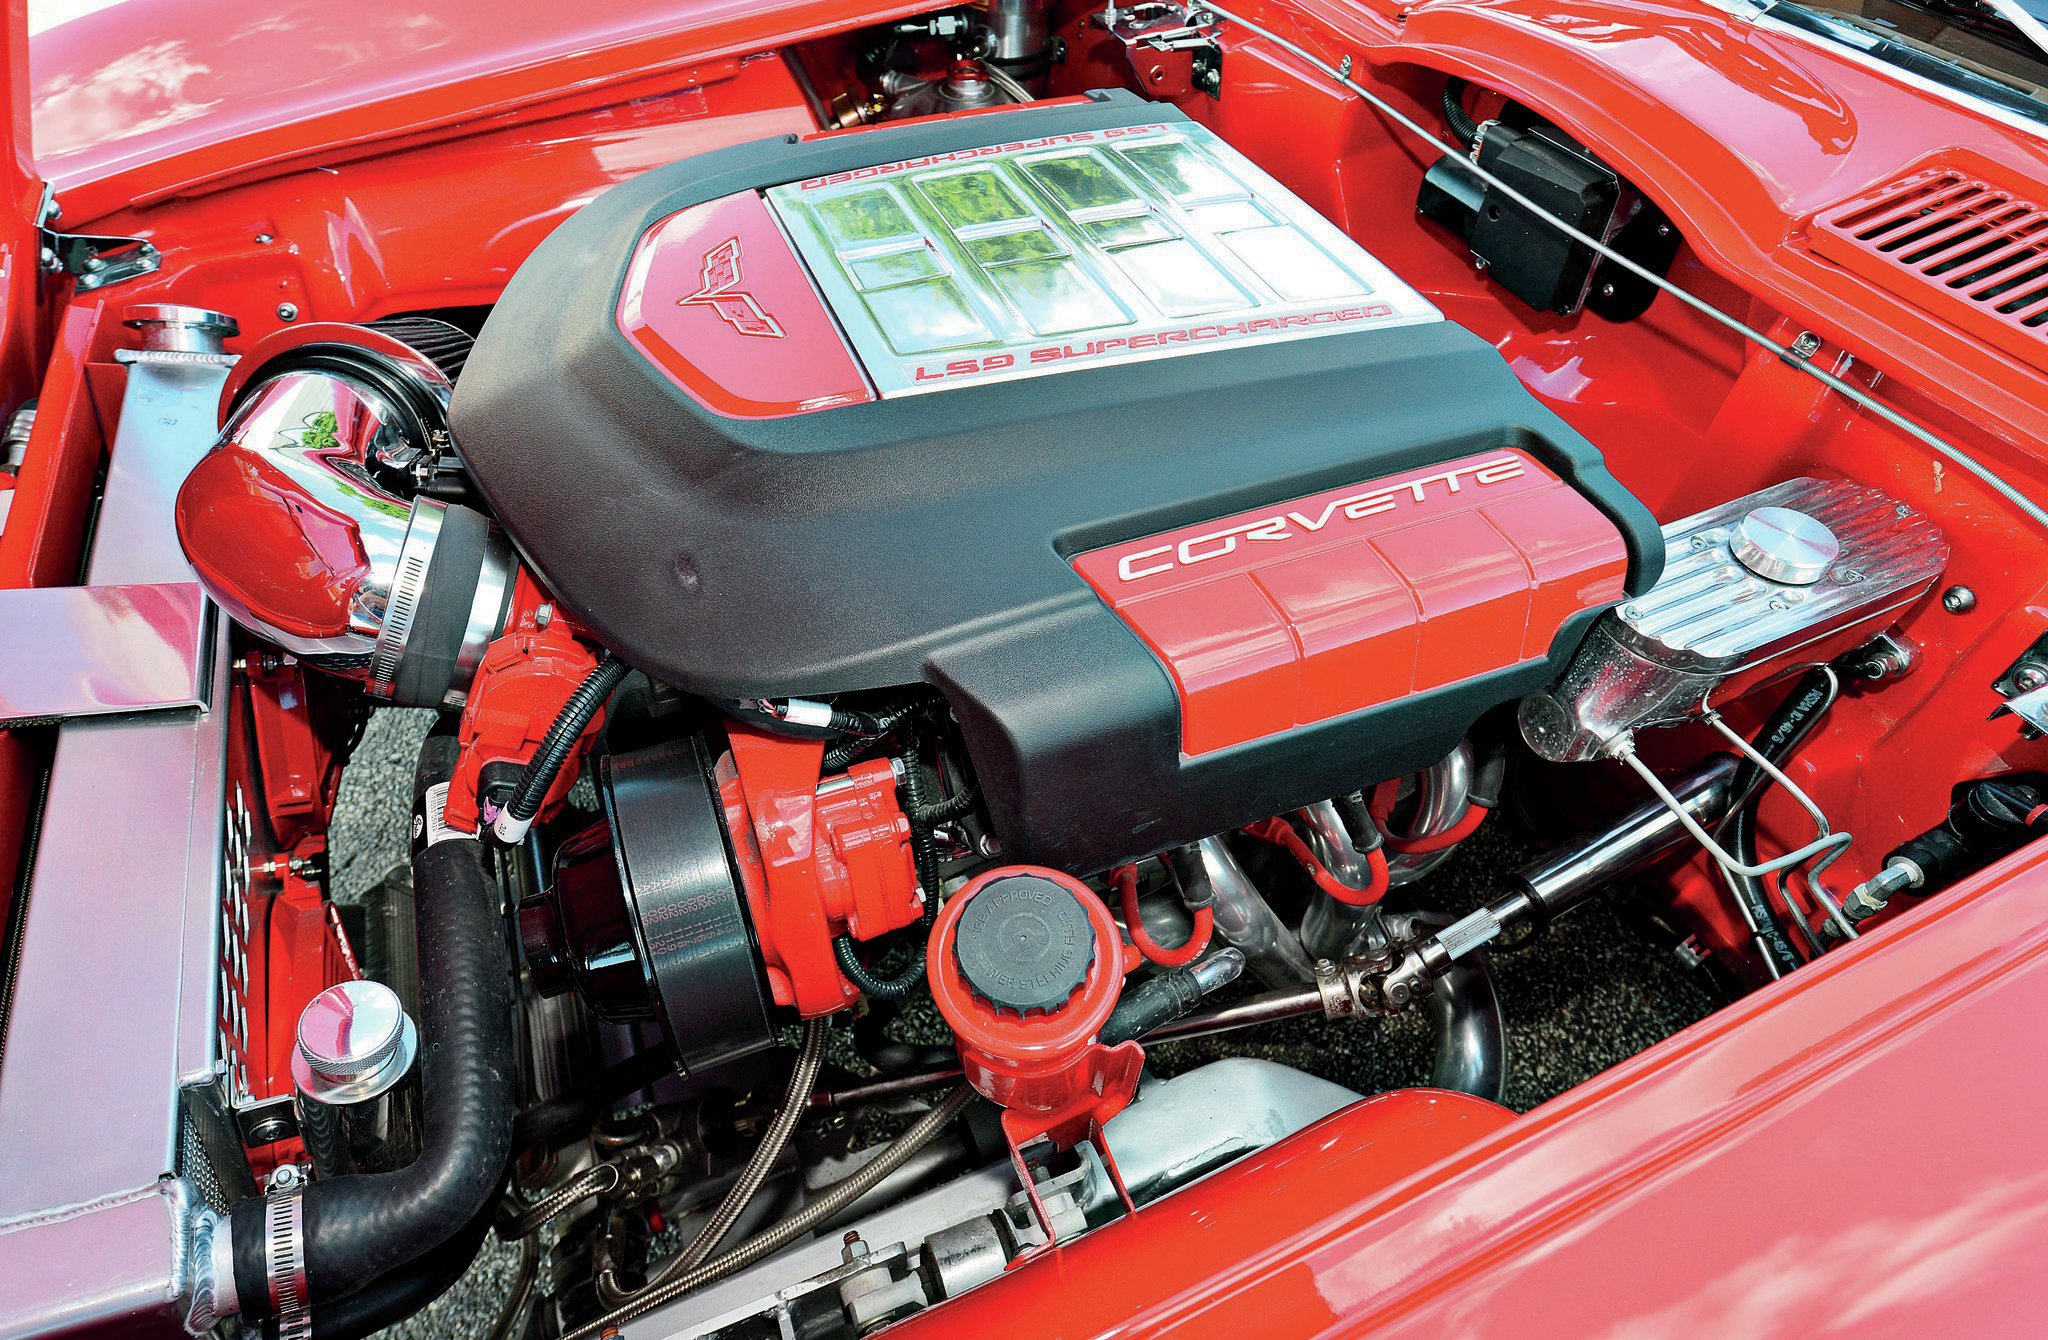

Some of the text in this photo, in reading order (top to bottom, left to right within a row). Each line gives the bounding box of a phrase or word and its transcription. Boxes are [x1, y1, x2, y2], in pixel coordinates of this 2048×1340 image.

[800, 123, 1169, 191] LS9 SUPERCHARGED
[914, 302, 1393, 382] LS9 SUPERCHARGED
[1117, 454, 1526, 583] CORVETTE
[985, 889, 1054, 914] APPROVED
[1019, 950, 1073, 990] STEERING
